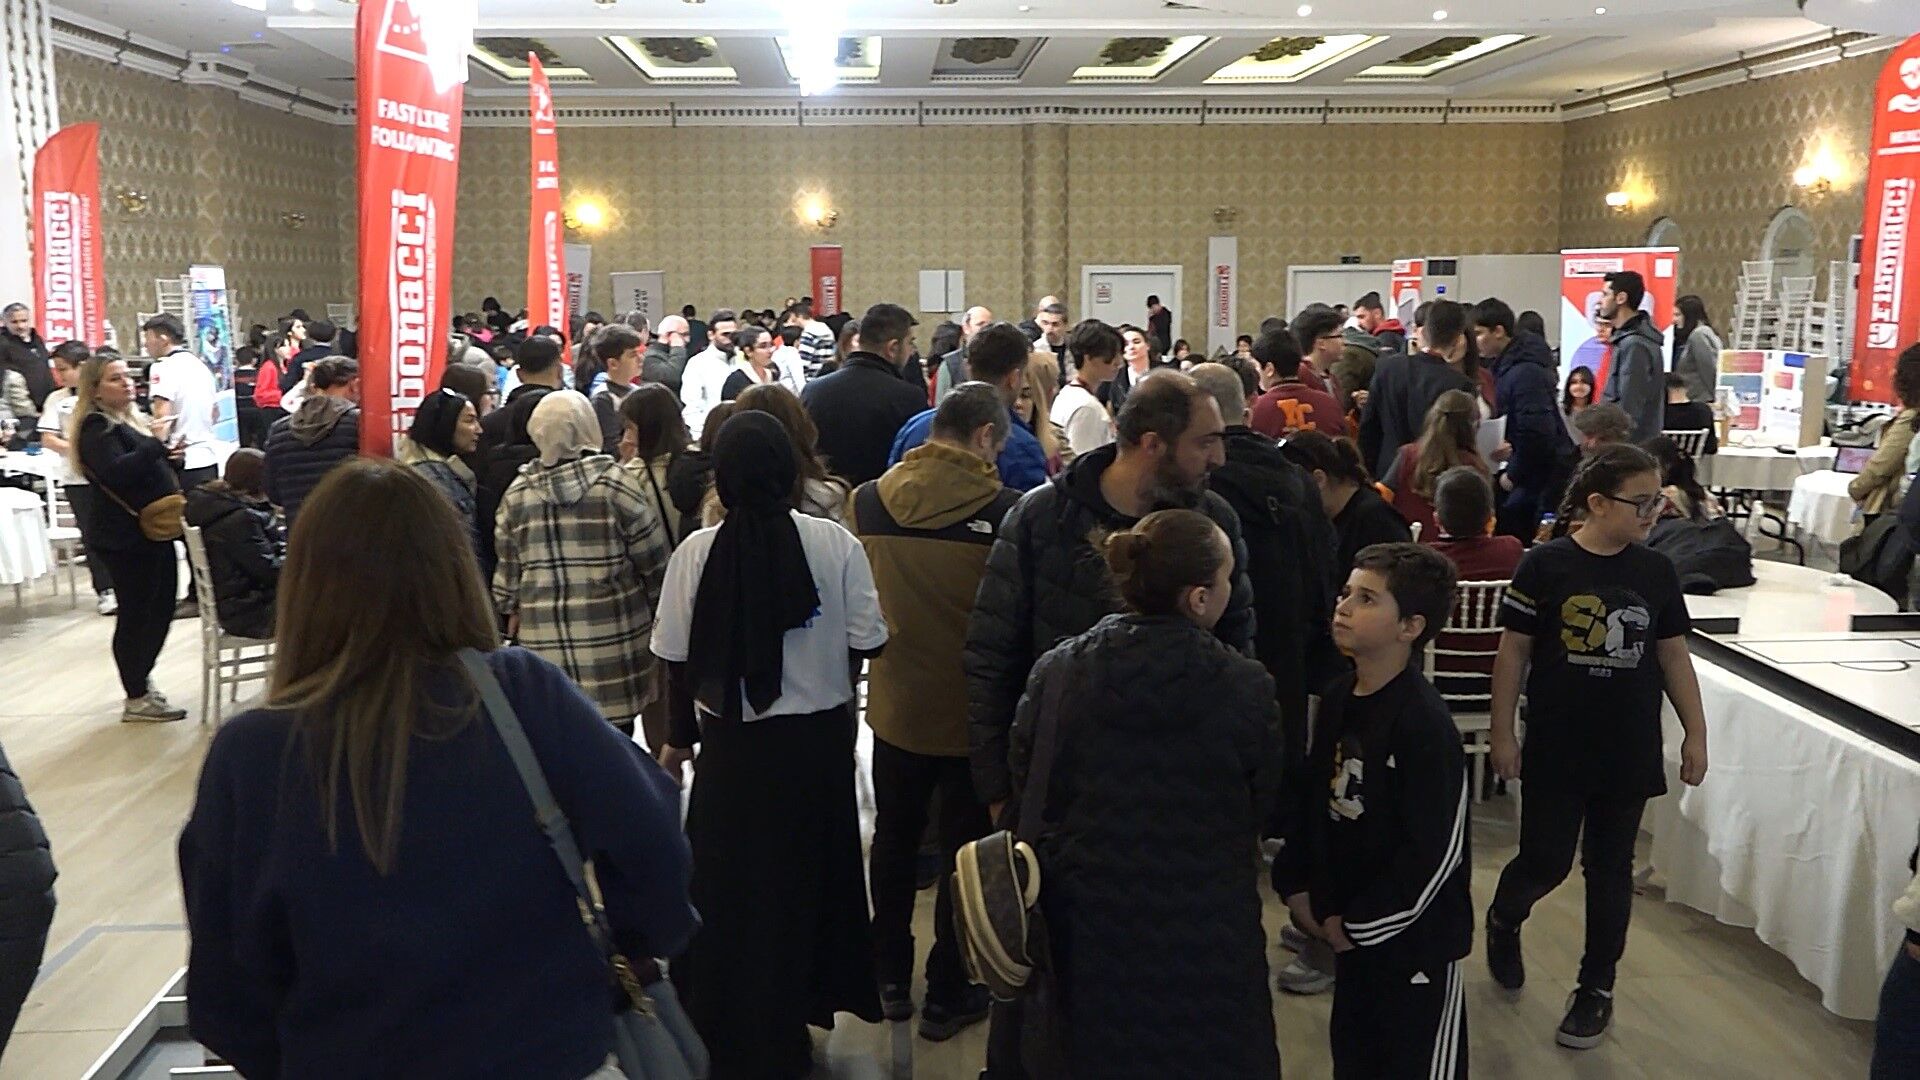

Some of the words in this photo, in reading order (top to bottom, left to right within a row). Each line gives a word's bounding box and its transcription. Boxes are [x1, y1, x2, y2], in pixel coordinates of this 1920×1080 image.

[371, 125, 455, 161] FOLLOWING
[378, 98, 416, 124] FAST
[1870, 177, 1908, 322] Fibonacci
[390, 188, 428, 445] ibonacci
[1560, 594, 1650, 659] SC
